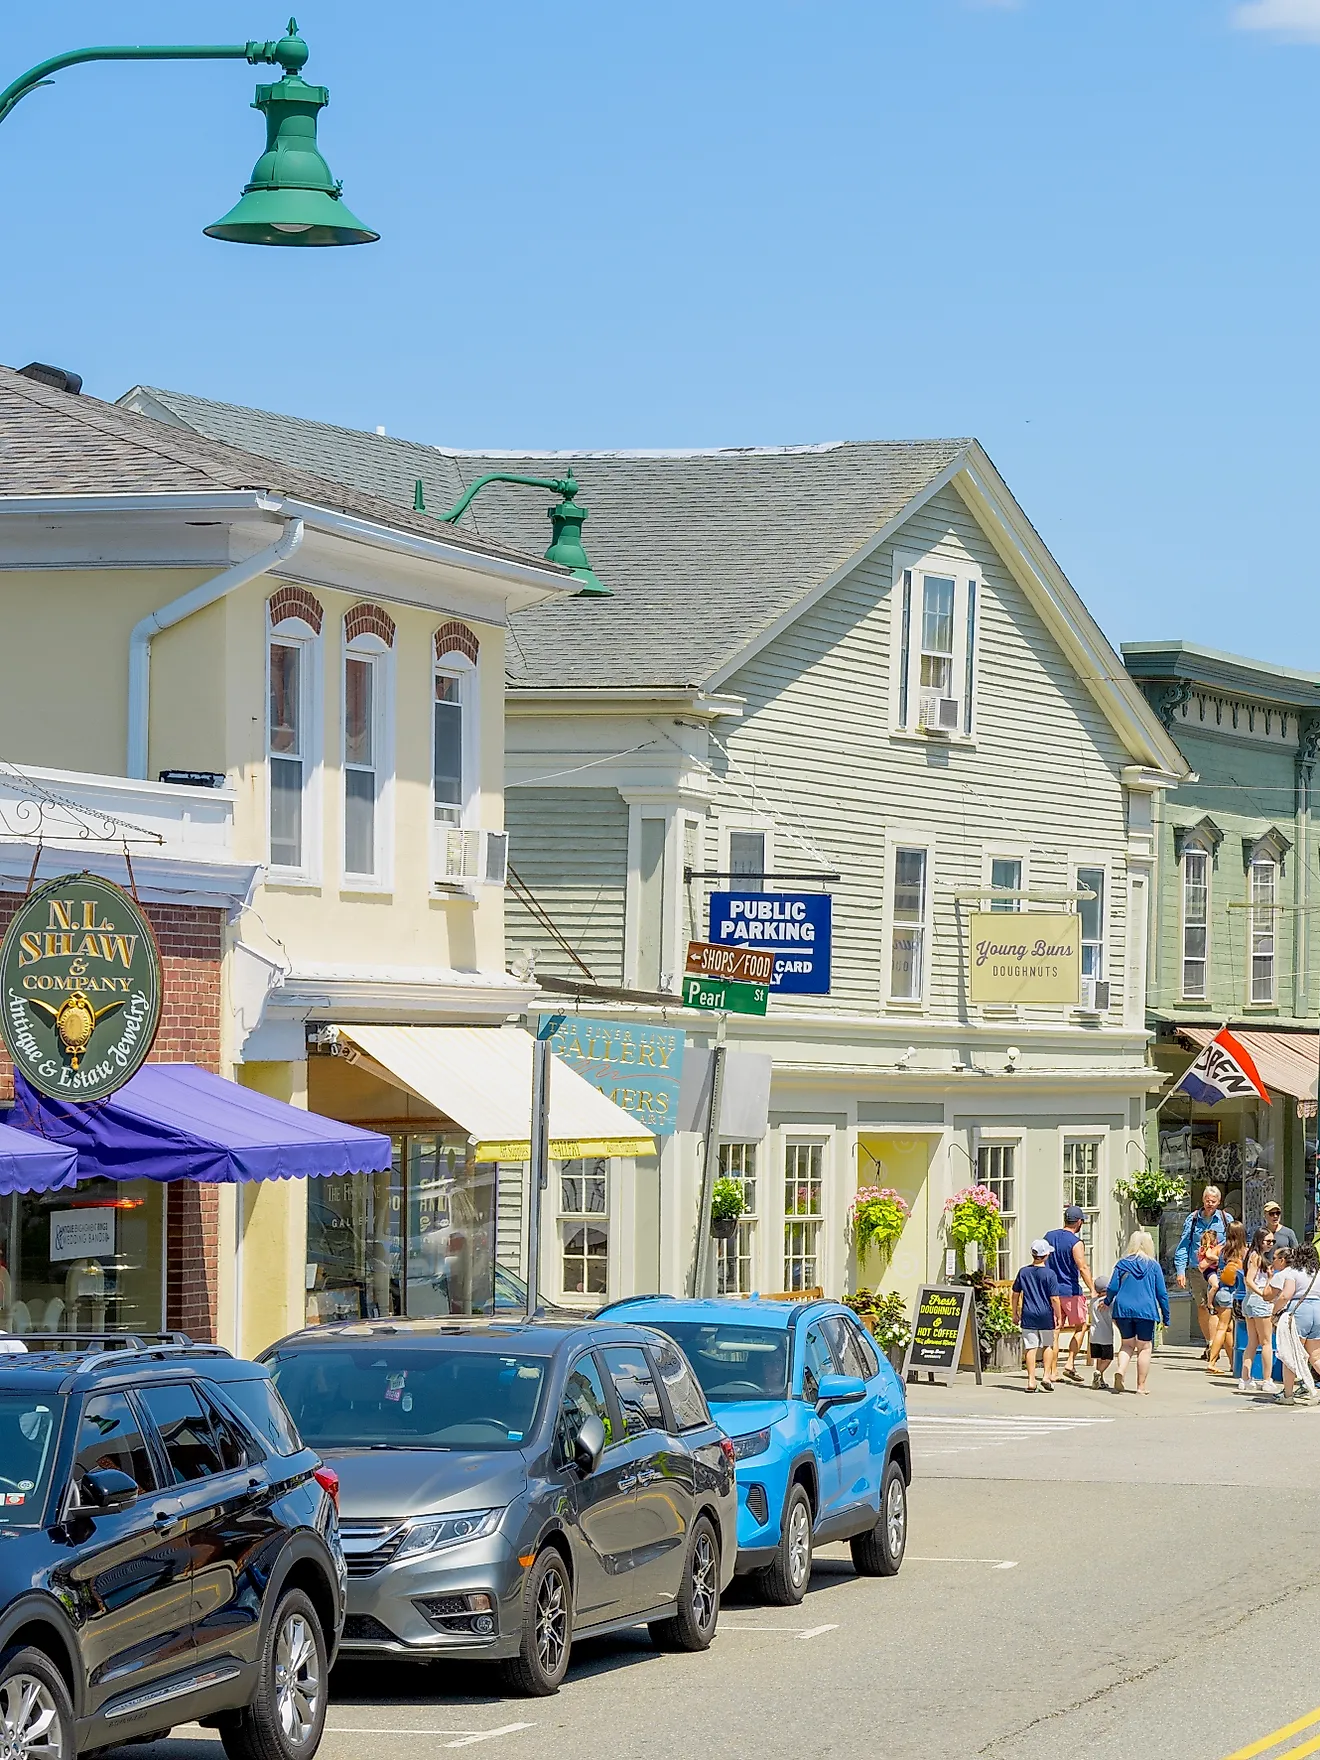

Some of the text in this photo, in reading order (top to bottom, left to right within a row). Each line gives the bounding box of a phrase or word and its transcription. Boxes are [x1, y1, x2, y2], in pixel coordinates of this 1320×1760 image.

[46, 899, 115, 931] N.L.
[729, 900, 806, 921] PUBLIC
[720, 920, 815, 941] PARKING
[18, 931, 138, 970] SHAW
[975, 939, 1074, 967] Young Buns
[69, 957, 89, 976] &
[701, 948, 771, 978] SHOPS/FOOD
[775, 960, 813, 974] CARD
[992, 965, 1058, 978] DOUGHNUTS
[23, 975, 134, 992] COMPANY
[769, 973, 784, 985] LY
[688, 981, 765, 1008] Pearl St
[8, 987, 150, 1090] Antique & Estate Jewelry
[548, 1021, 677, 1046] THE FINER LINE
[546, 1034, 675, 1069] GALLERY
[1194, 1045, 1256, 1093] OPEN
[597, 1086, 669, 1115] MERS
[639, 1114, 666, 1126] ART
[920, 1305, 960, 1316] DOUGHNUTS
[928, 1294, 957, 1306] Fresh
[917, 1327, 958, 1338] HOT COFFEE
[932, 1317, 942, 1327] &
